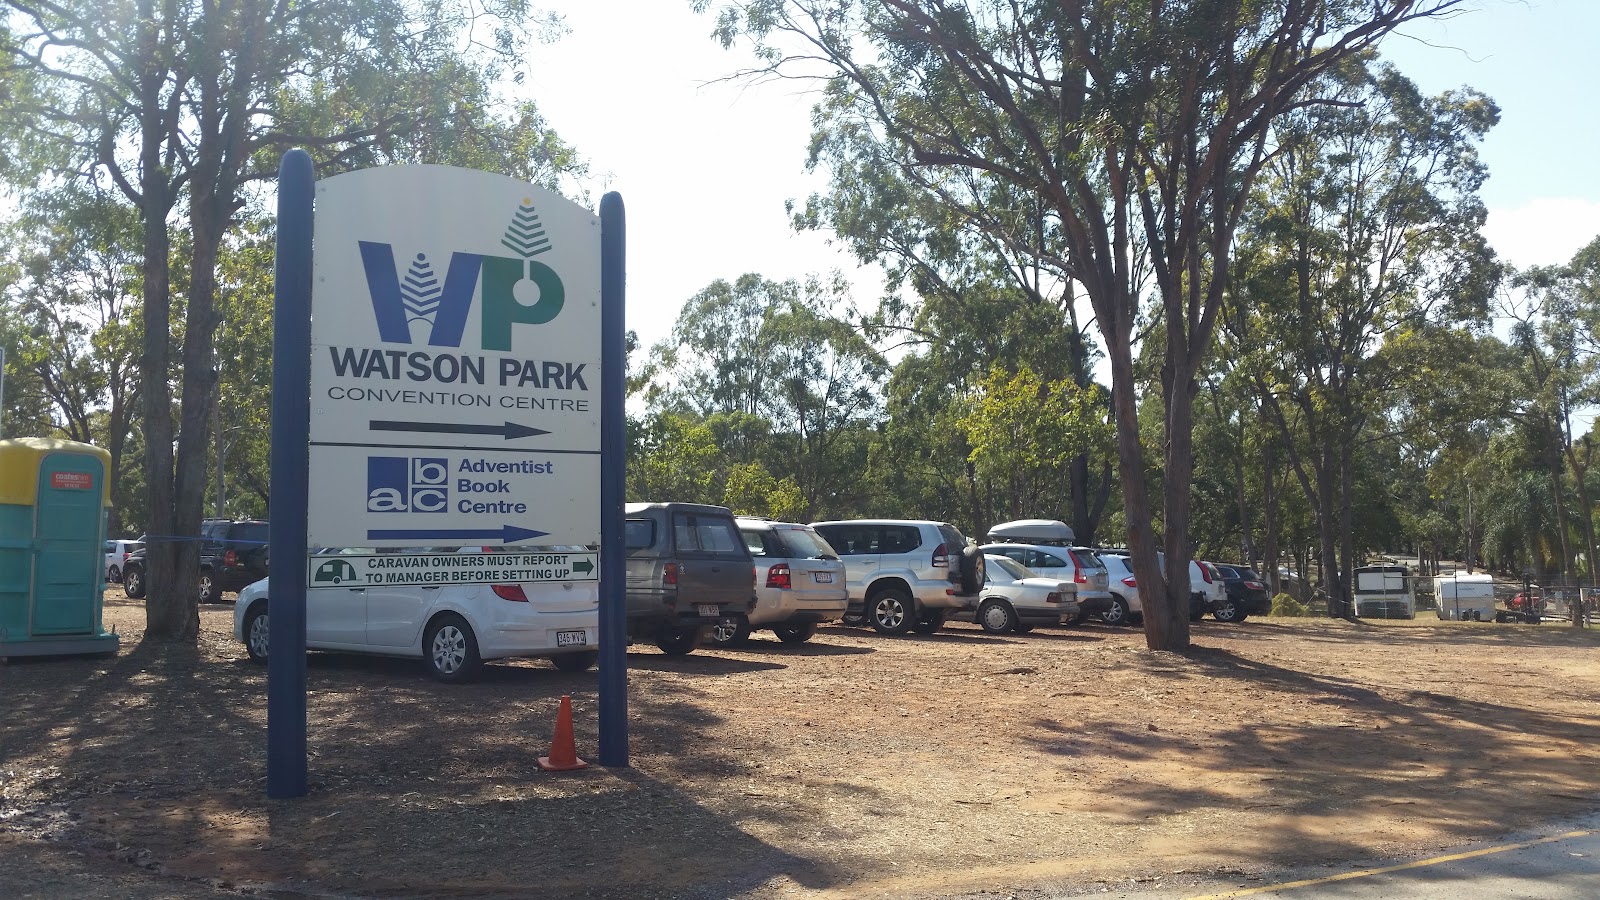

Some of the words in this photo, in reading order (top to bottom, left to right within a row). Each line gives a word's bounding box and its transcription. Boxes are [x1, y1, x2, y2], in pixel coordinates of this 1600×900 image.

[329, 347, 485, 385] WATSON
[499, 358, 589, 391] PARK
[328, 386, 491, 407] CONVENTION
[499, 395, 589, 412] CENTRE
[458, 458, 553, 474] Adventist
[457, 478, 510, 493] Book
[457, 499, 527, 514] Centre
[368, 557, 429, 569] CARAVAN
[431, 556, 485, 568] OWNERS
[487, 556, 520, 567] MUST
[523, 555, 568, 566] REPORT
[366, 573, 382, 583] TO
[386, 571, 450, 583] MANAGER
[452, 570, 500, 581] BEFORE
[502, 569, 552, 580] SETTING
[554, 568, 570, 579] UP
